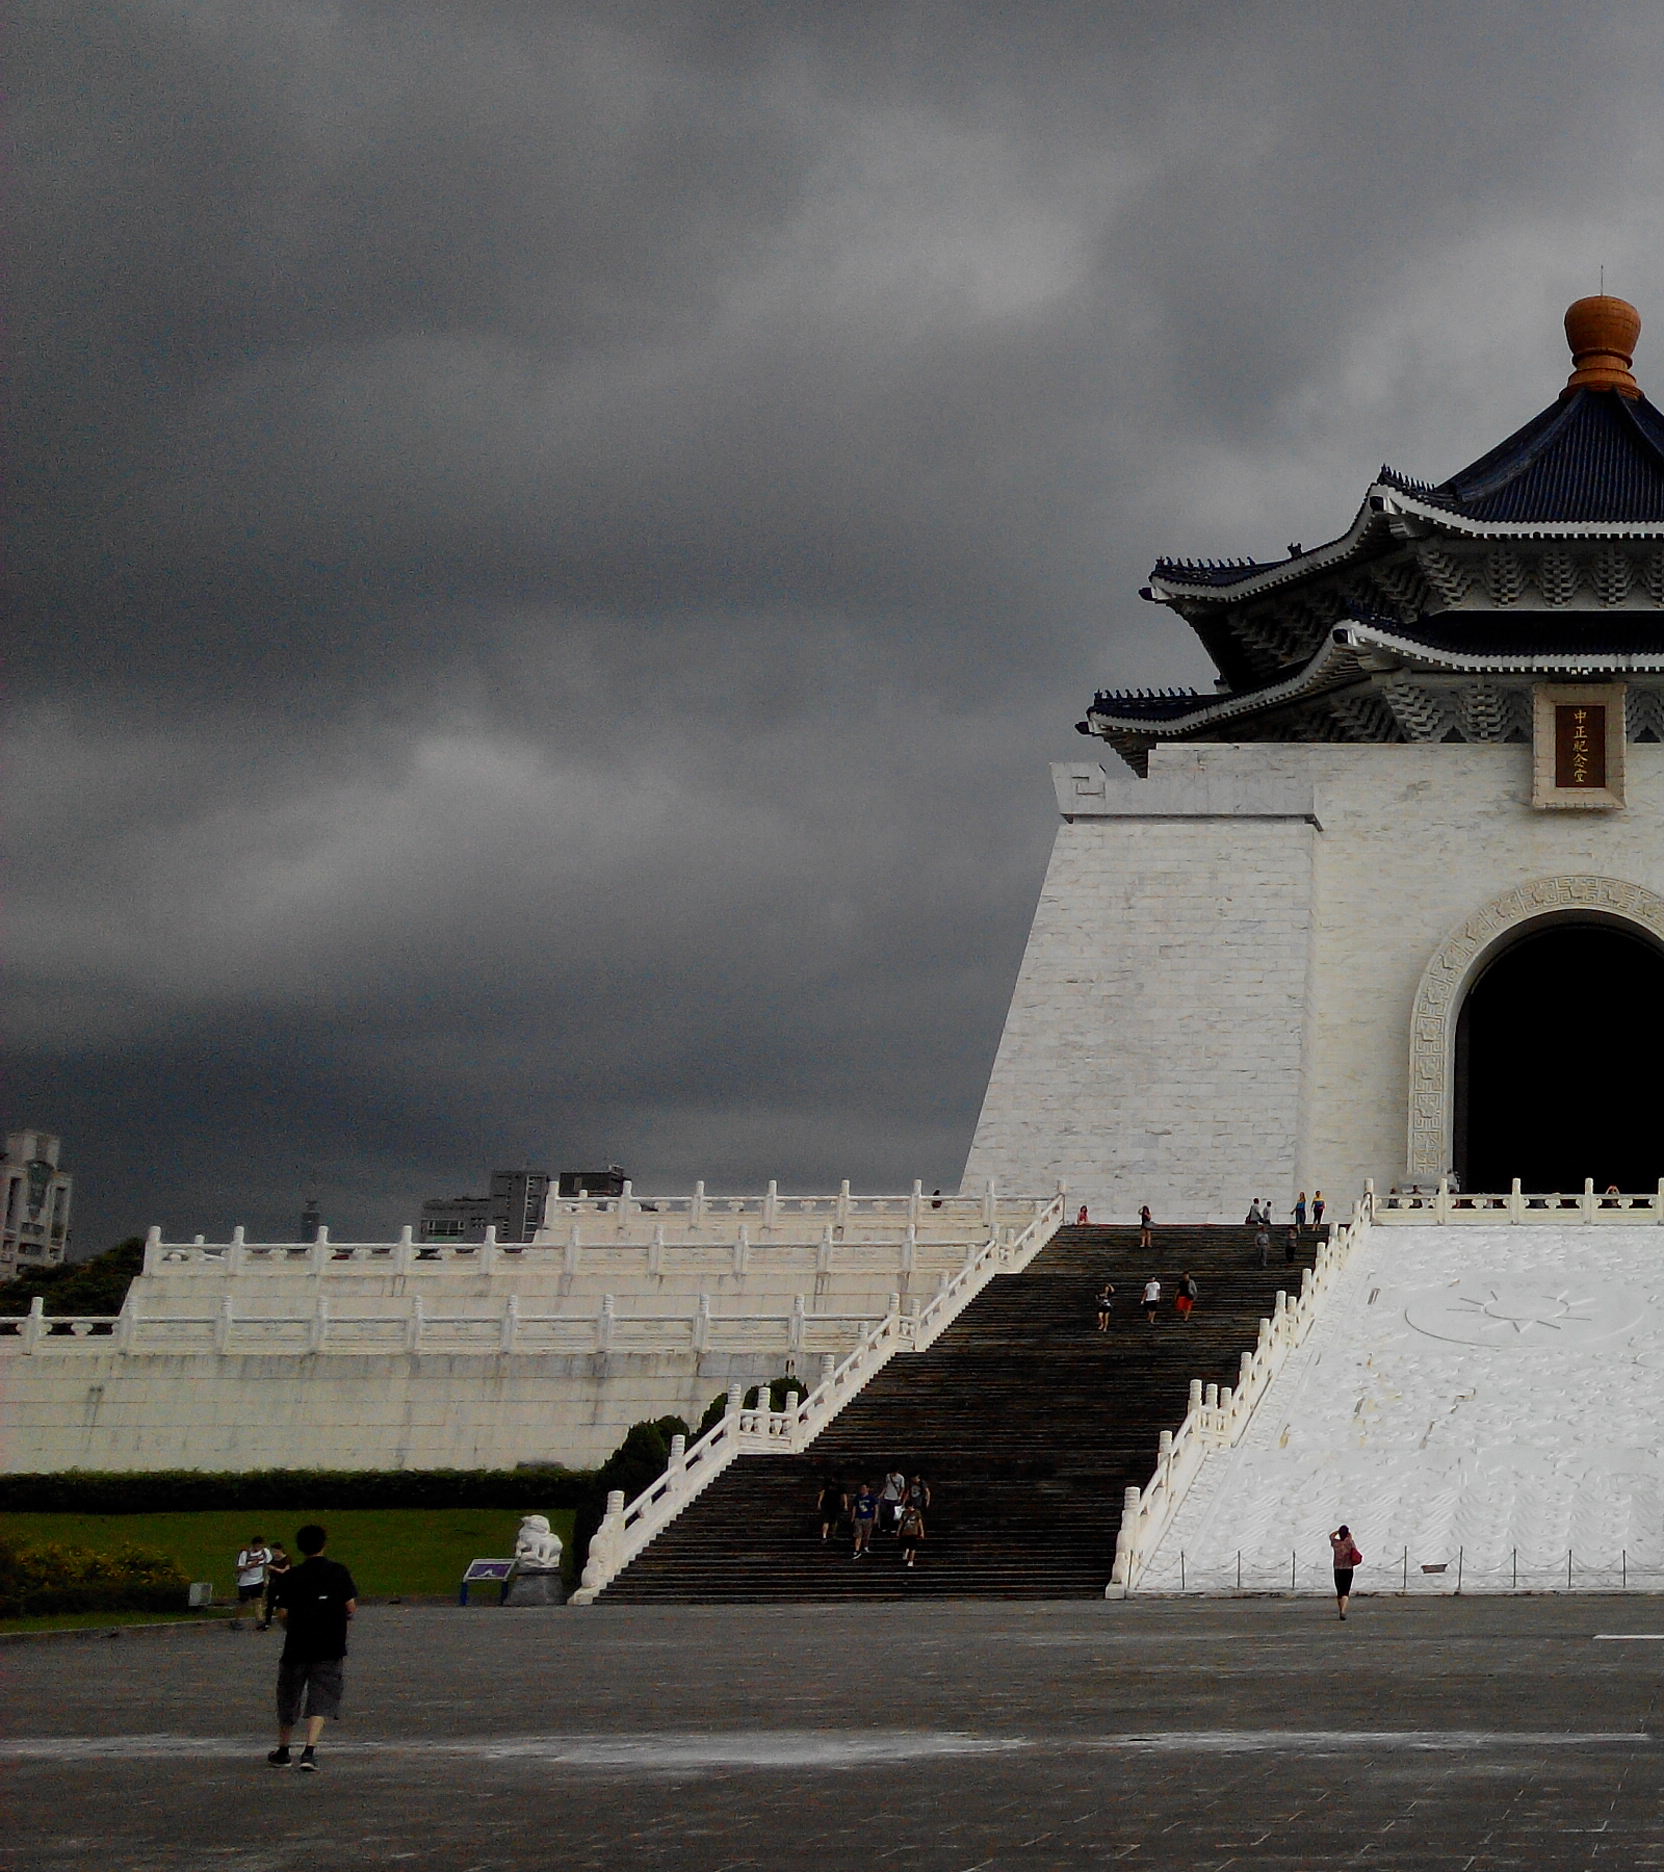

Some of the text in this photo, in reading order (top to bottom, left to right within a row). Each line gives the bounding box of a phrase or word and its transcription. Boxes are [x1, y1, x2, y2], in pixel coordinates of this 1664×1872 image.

[1572, 709, 1589, 783] 中正紀念堂
